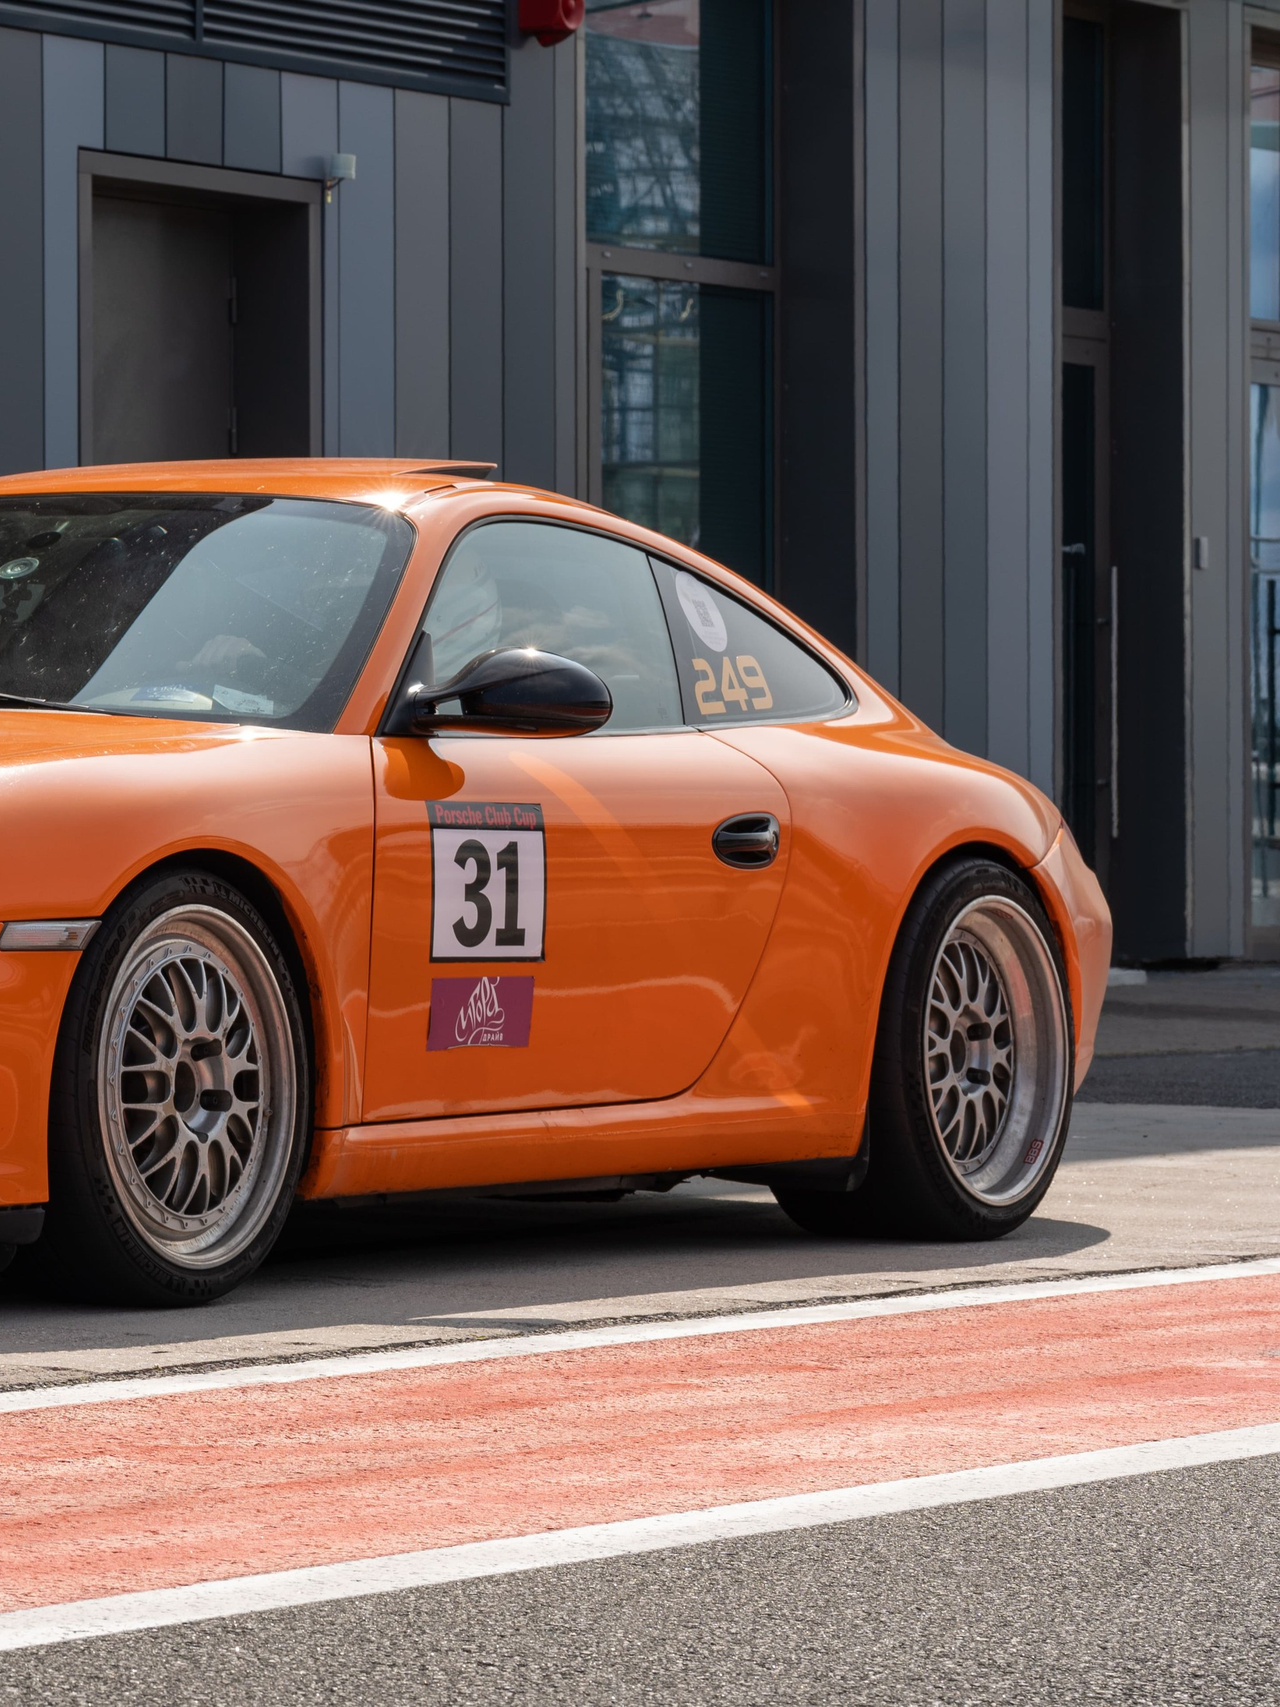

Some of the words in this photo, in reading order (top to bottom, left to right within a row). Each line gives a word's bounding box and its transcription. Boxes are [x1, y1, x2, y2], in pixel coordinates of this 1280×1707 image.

[691, 655, 773, 715] 249
[435, 804, 482, 825] Porsche
[485, 805, 511, 826] Club
[513, 806, 537, 830] Cup
[452, 838, 526, 948] 31
[228, 891, 280, 956] MICHELIN
[105, 939, 120, 966] Cup
[1024, 1140, 1043, 1164] BBS
